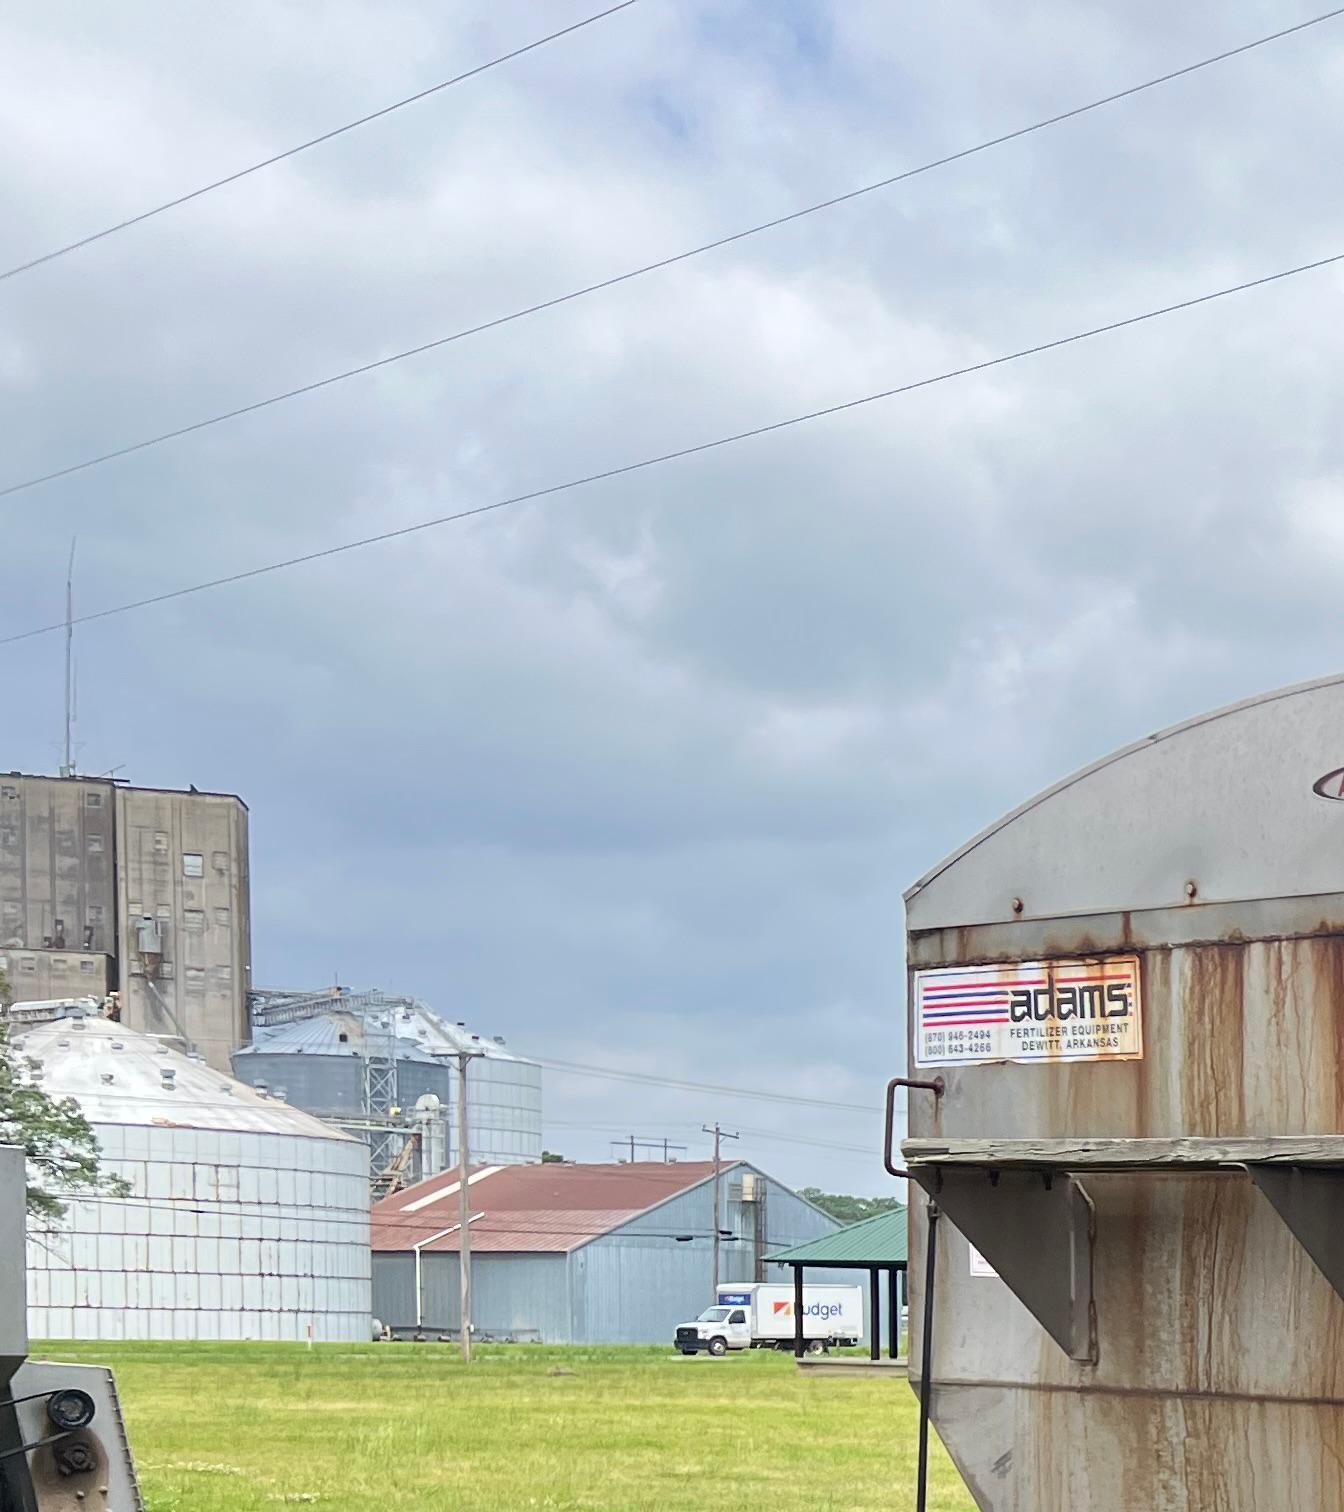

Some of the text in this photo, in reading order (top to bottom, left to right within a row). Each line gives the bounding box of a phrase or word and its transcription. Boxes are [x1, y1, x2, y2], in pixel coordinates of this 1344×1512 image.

[1008, 971, 1128, 1022] adams
[1010, 1023, 1129, 1038] FERTILIZER EQUIPMENT
[1066, 1037, 1119, 1050] ARKANSAS
[797, 1302, 842, 1320] udget
